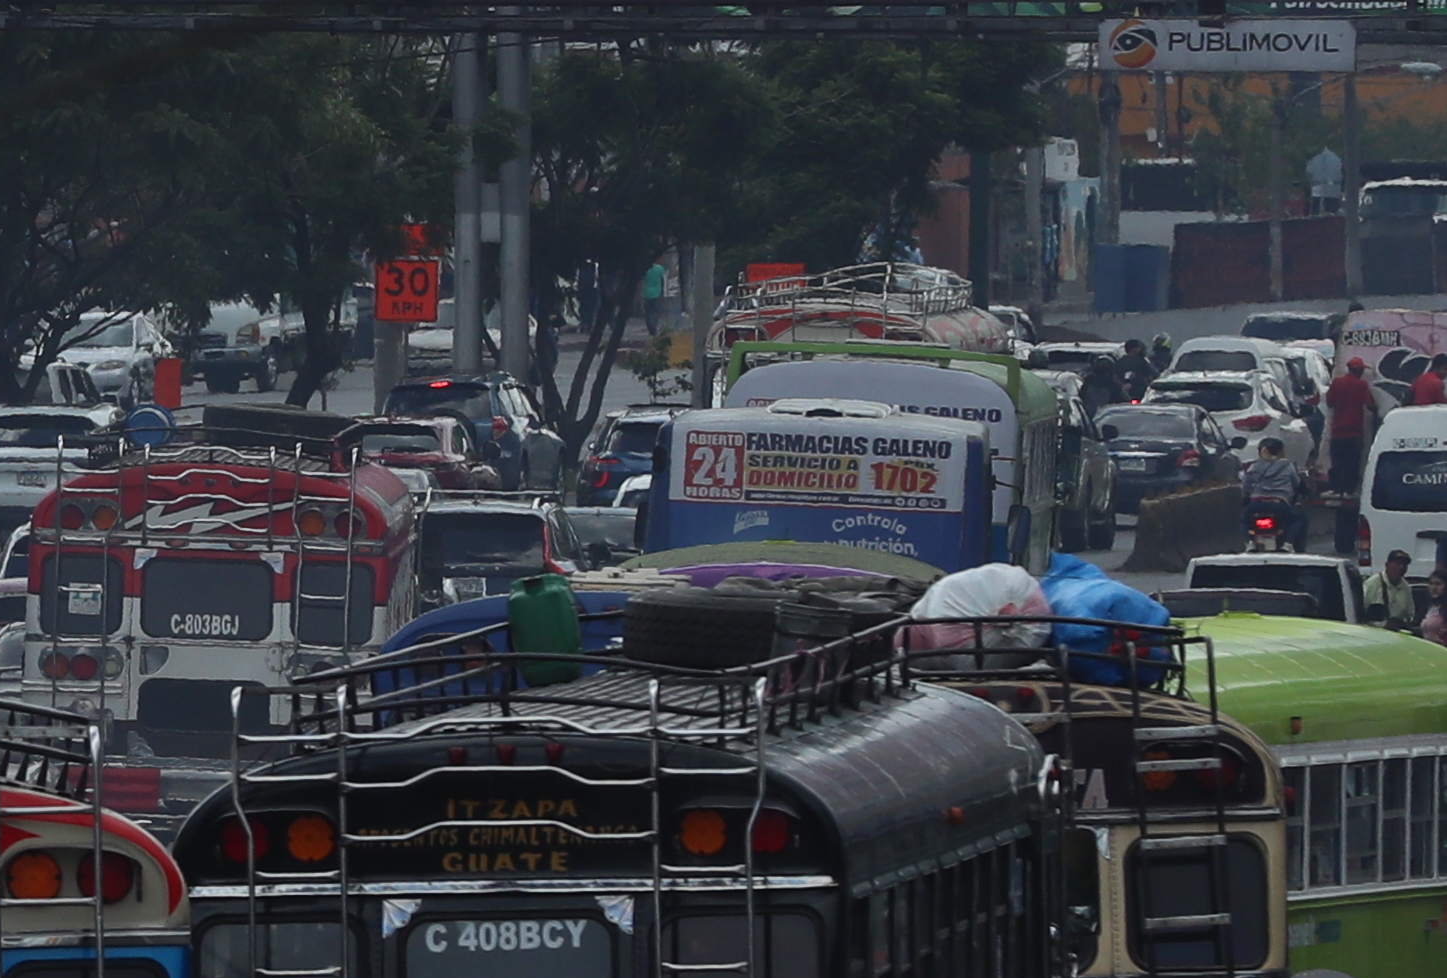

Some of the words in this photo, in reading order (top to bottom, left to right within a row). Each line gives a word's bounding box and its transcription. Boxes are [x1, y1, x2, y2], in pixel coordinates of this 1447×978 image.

[1168, 31, 1340, 52] PUBLIMOVIL
[384, 266, 430, 296] 30
[689, 433, 743, 446] ABIERTO
[747, 433, 869, 456] FARMACIAS
[872, 437, 952, 460] GALENO
[691, 446, 738, 487] 24
[748, 454, 841, 471] SERVICIO
[846, 459, 859, 471] A
[748, 469, 858, 490] DOMICILIO
[870, 461, 937, 494] 1702
[685, 486, 741, 499] HORAS
[831, 512, 907, 535] Controla
[170, 613, 240, 635] C-803BGJ
[442, 851, 570, 873] GUATE
[424, 923, 448, 953] C
[457, 918, 588, 951] 408BCY
